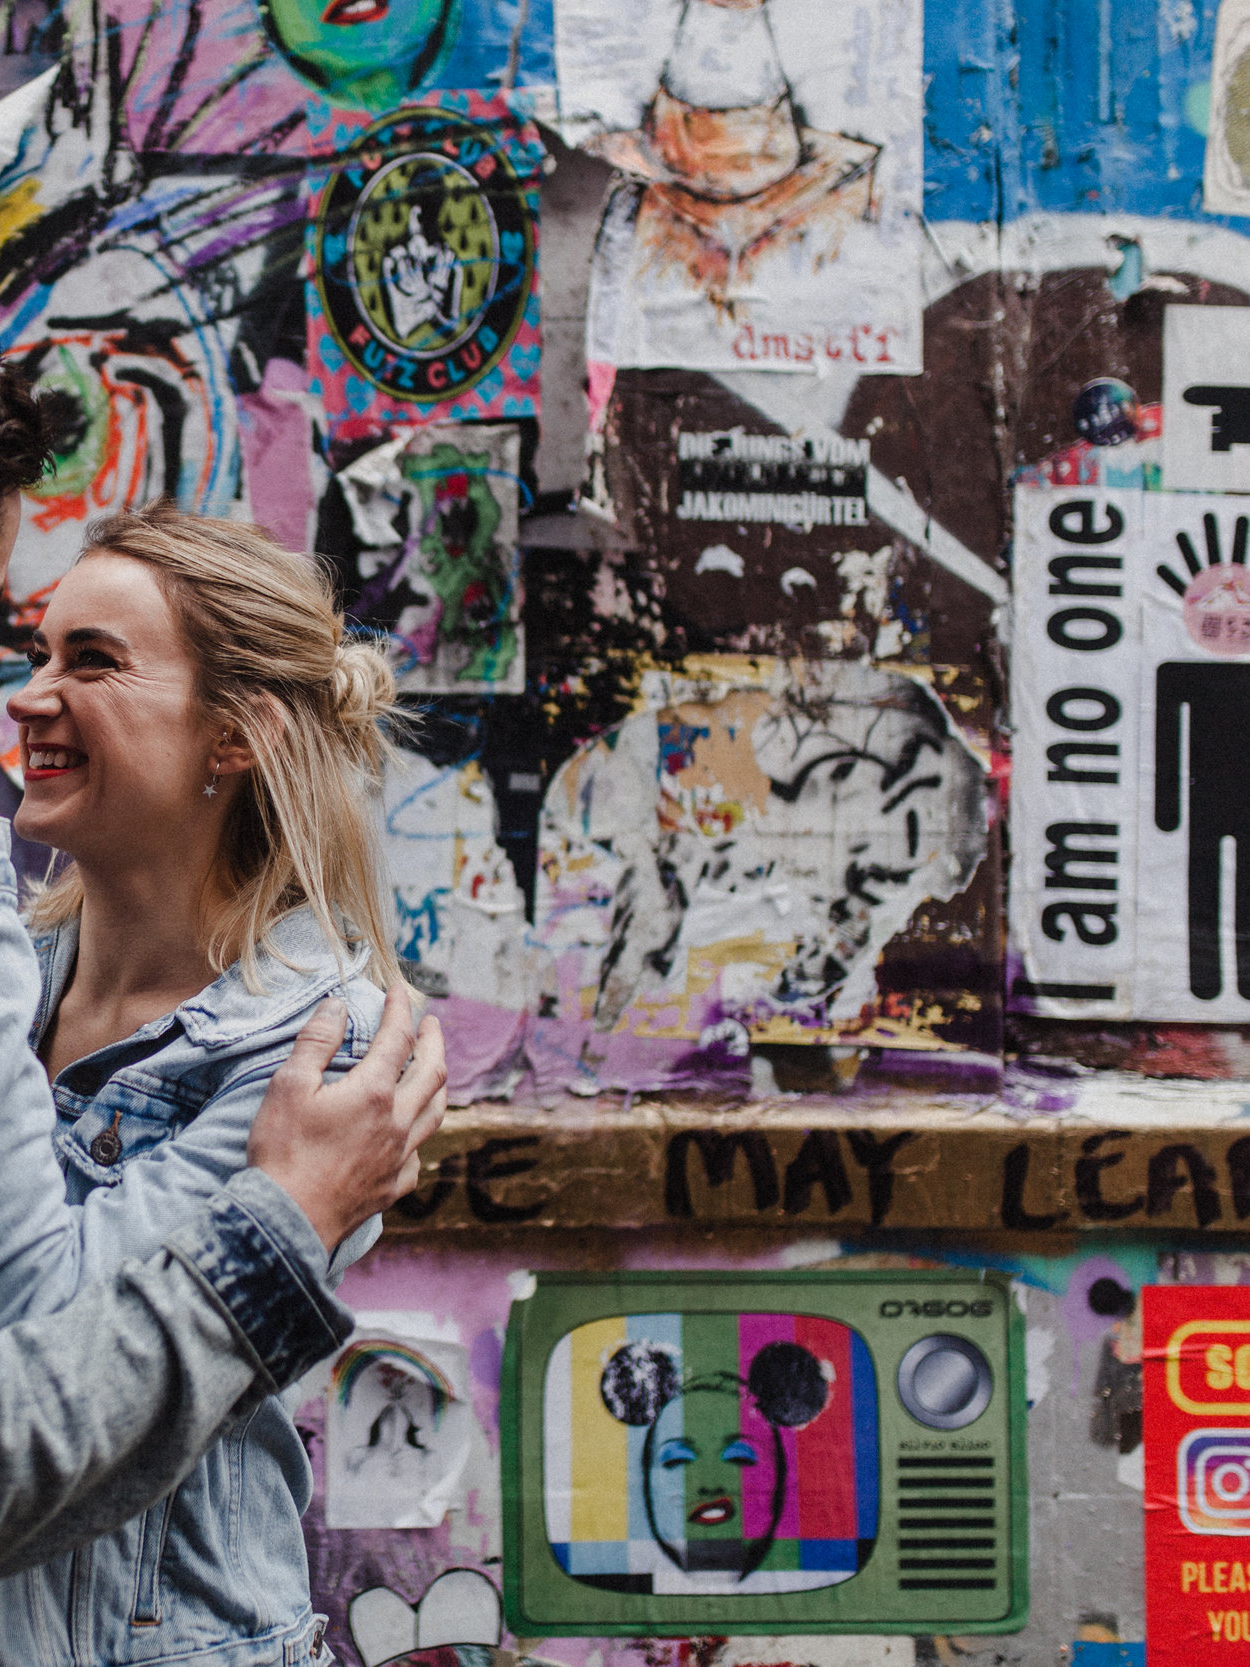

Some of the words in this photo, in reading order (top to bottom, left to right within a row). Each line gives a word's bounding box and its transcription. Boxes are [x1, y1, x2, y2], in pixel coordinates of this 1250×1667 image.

[426, 325, 499, 388] CLUB
[1047, 500, 1125, 651] one
[1046, 687, 1123, 784] no
[1041, 822, 1120, 946] am
[1012, 980, 1117, 1001] I
[664, 1127, 920, 1227] MAY
[1181, 1561, 1250, 1594] PLEA
